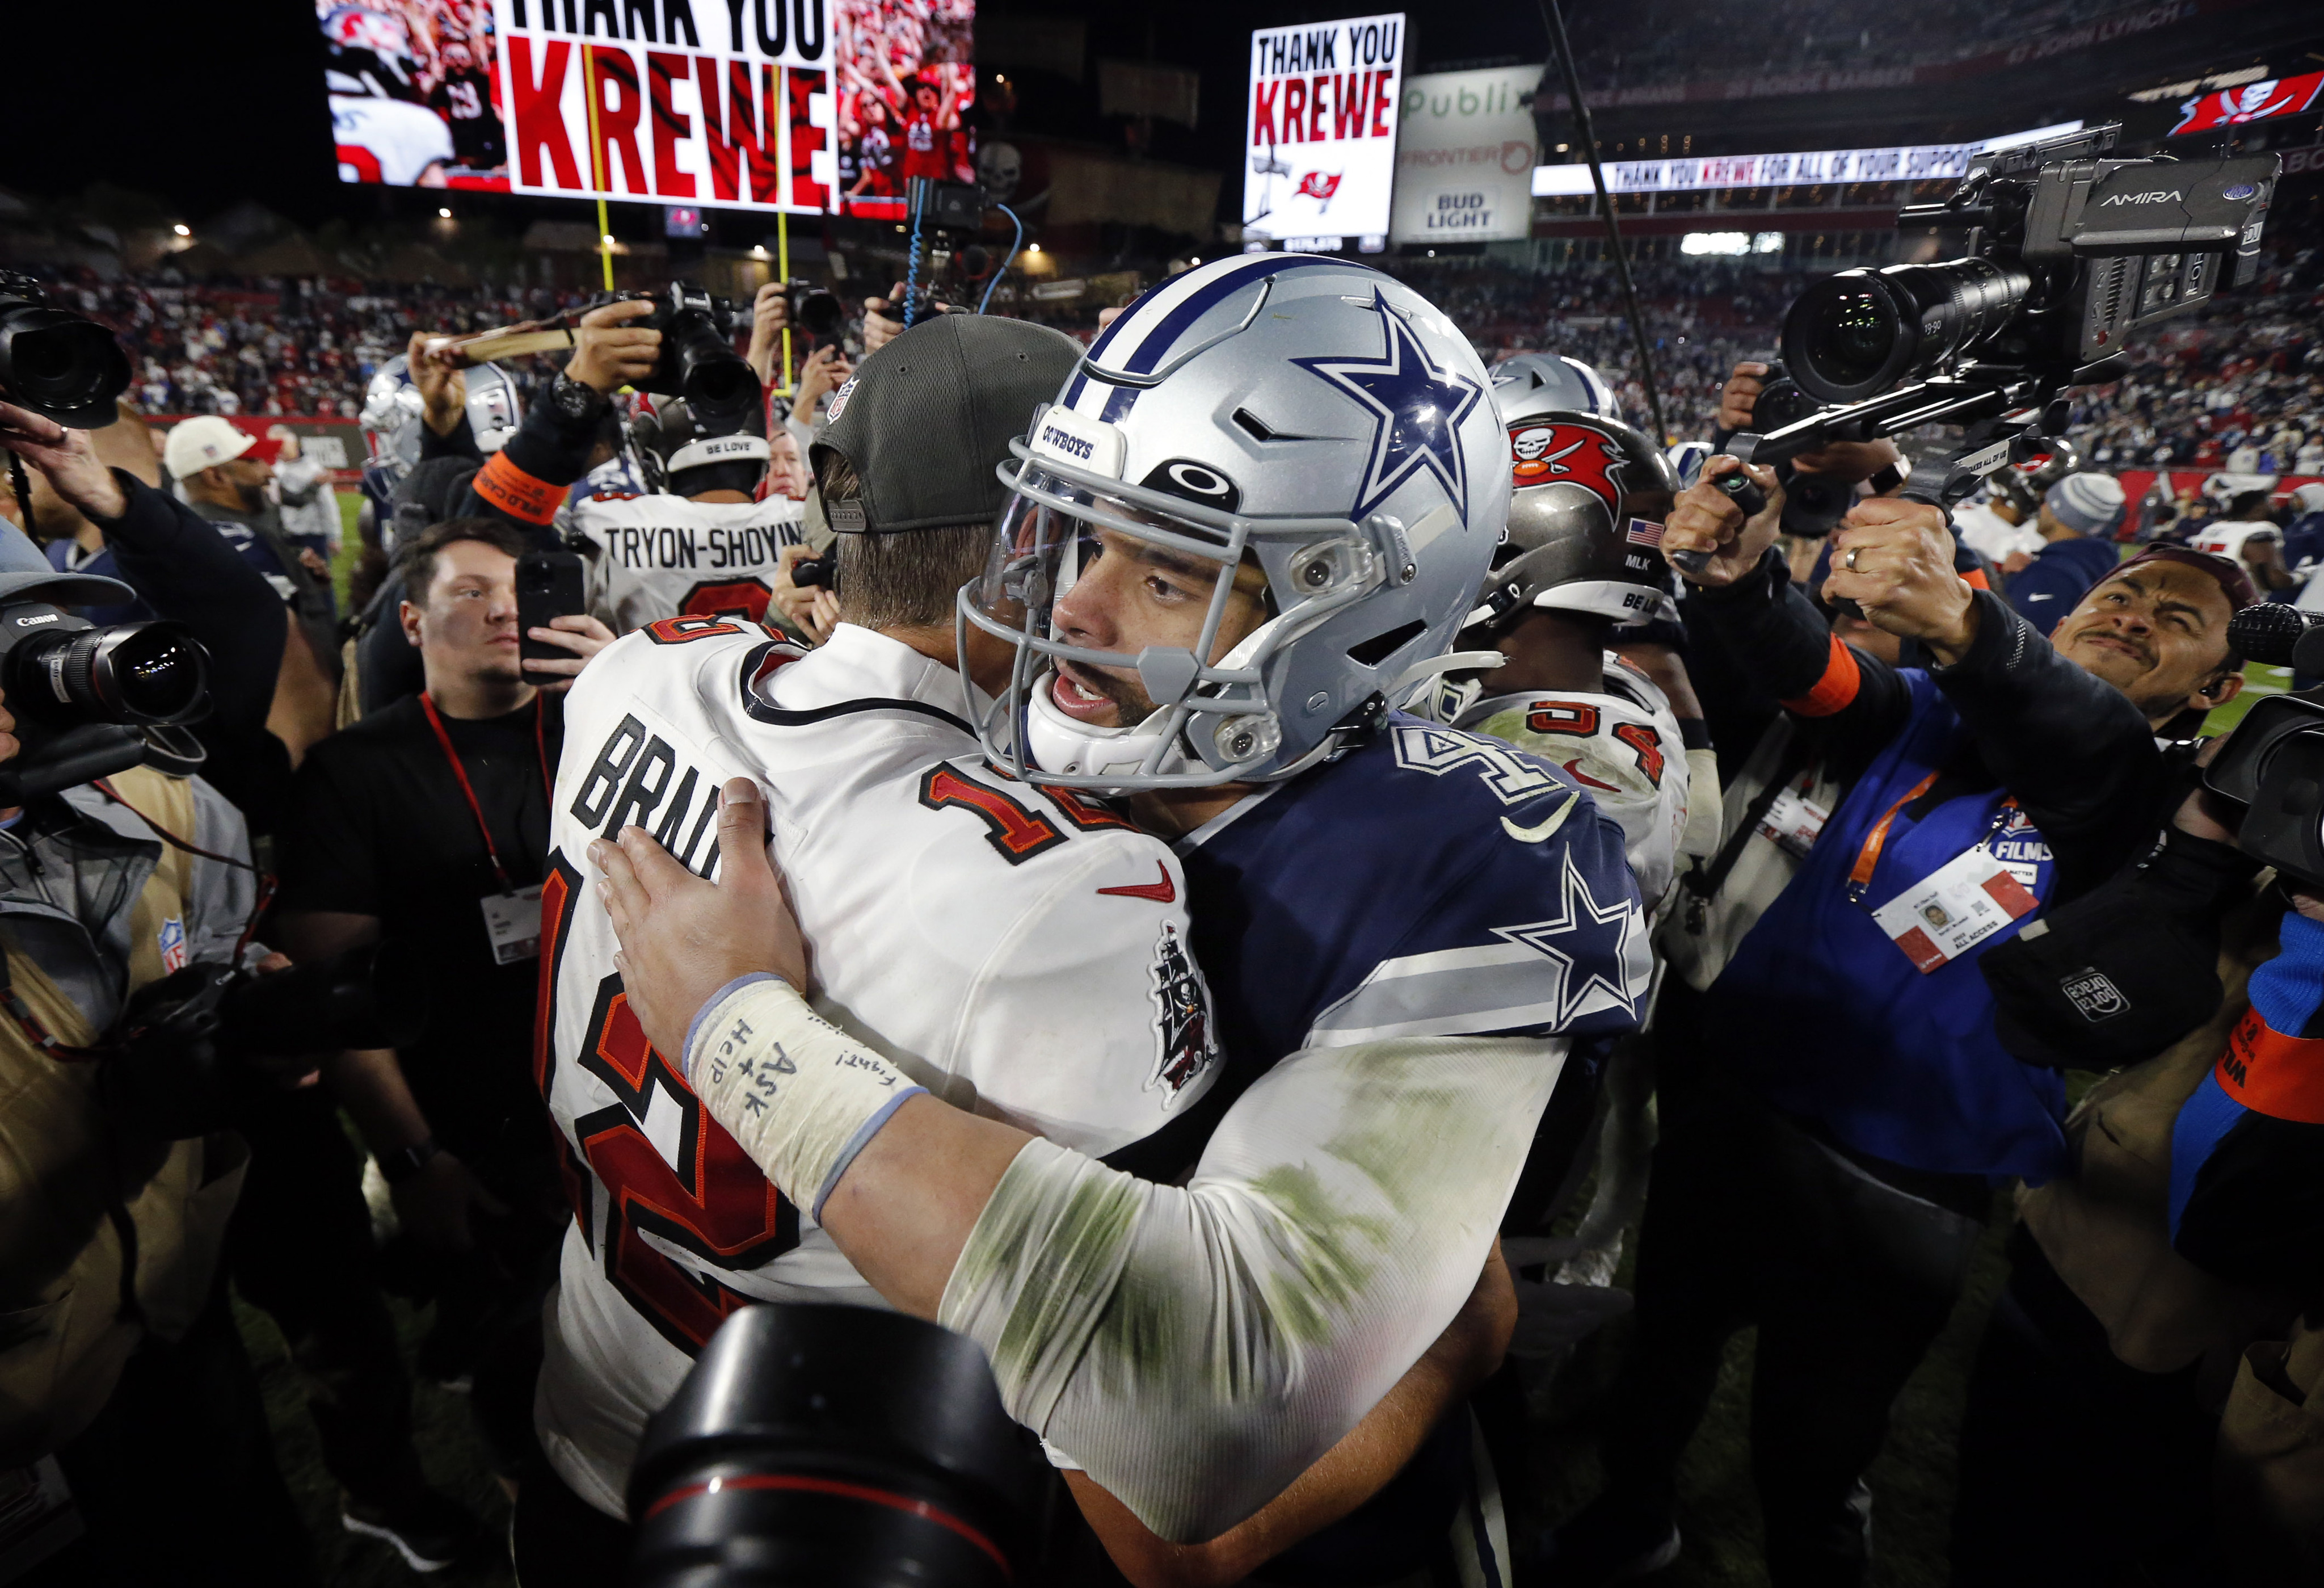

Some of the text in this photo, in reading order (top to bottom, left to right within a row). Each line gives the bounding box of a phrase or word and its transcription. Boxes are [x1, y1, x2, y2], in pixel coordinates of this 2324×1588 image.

[1259, 22, 1397, 76] THANK YOU
[1254, 70, 1393, 146] KREWE
[507, 35, 831, 207] KREWE
[1617, 166, 1660, 186] THANK
[1672, 164, 1698, 183] YOU
[1703, 161, 1753, 182] KREWE
[1763, 159, 1788, 179] FOR
[1797, 158, 1821, 178] ALL
[1832, 157, 1847, 177] OF
[1859, 154, 1898, 175] YOUR
[1438, 193, 1484, 210] BUD
[2101, 190, 2182, 207] AMIRA
[1428, 210, 1492, 228] LIGHT
[706, 442, 752, 455] BE LOVE
[1042, 425, 1094, 460] COWBOYS
[1983, 457, 1992, 467] ALL
[1993, 453, 1999, 462] OF
[1624, 553, 1652, 571] MLK
[1623, 593, 1643, 610] BE
[16, 613, 58, 627] Canon
[1390, 725, 1568, 806] 4
[1995, 841, 2054, 862] FILMS
[164, 944, 187, 975] NF
[2067, 976, 2107, 998] brace
[2077, 988, 2118, 1010] porta
